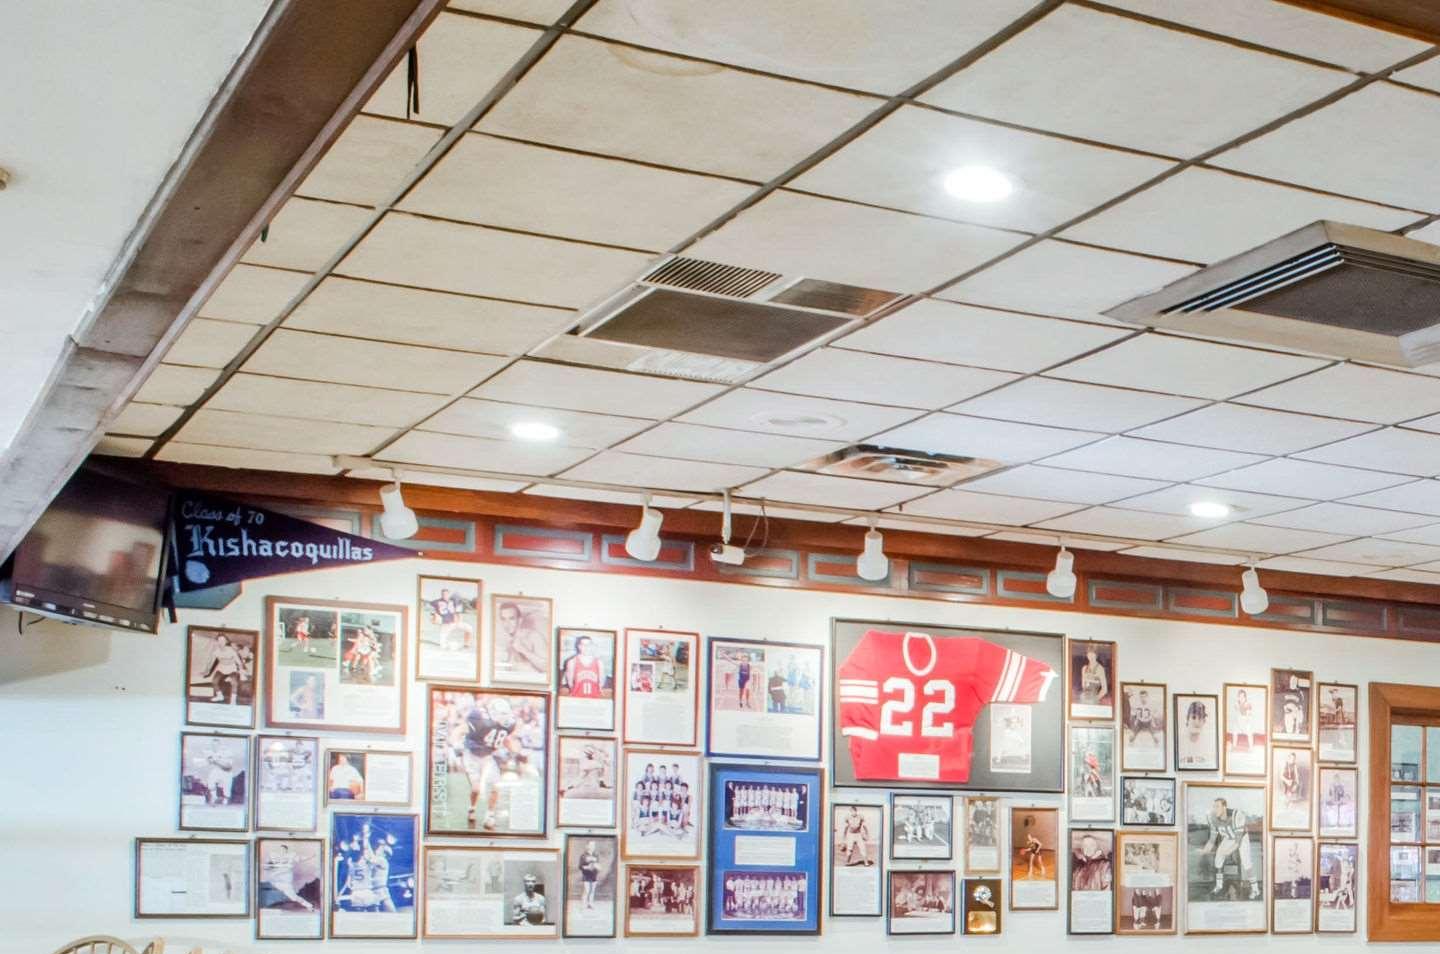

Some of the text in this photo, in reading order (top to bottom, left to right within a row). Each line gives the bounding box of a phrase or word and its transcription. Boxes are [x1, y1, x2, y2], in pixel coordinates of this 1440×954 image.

[181, 500, 265, 526] Class of 70
[184, 524, 374, 565] Kishacoquillas
[880, 677, 956, 738] 22
